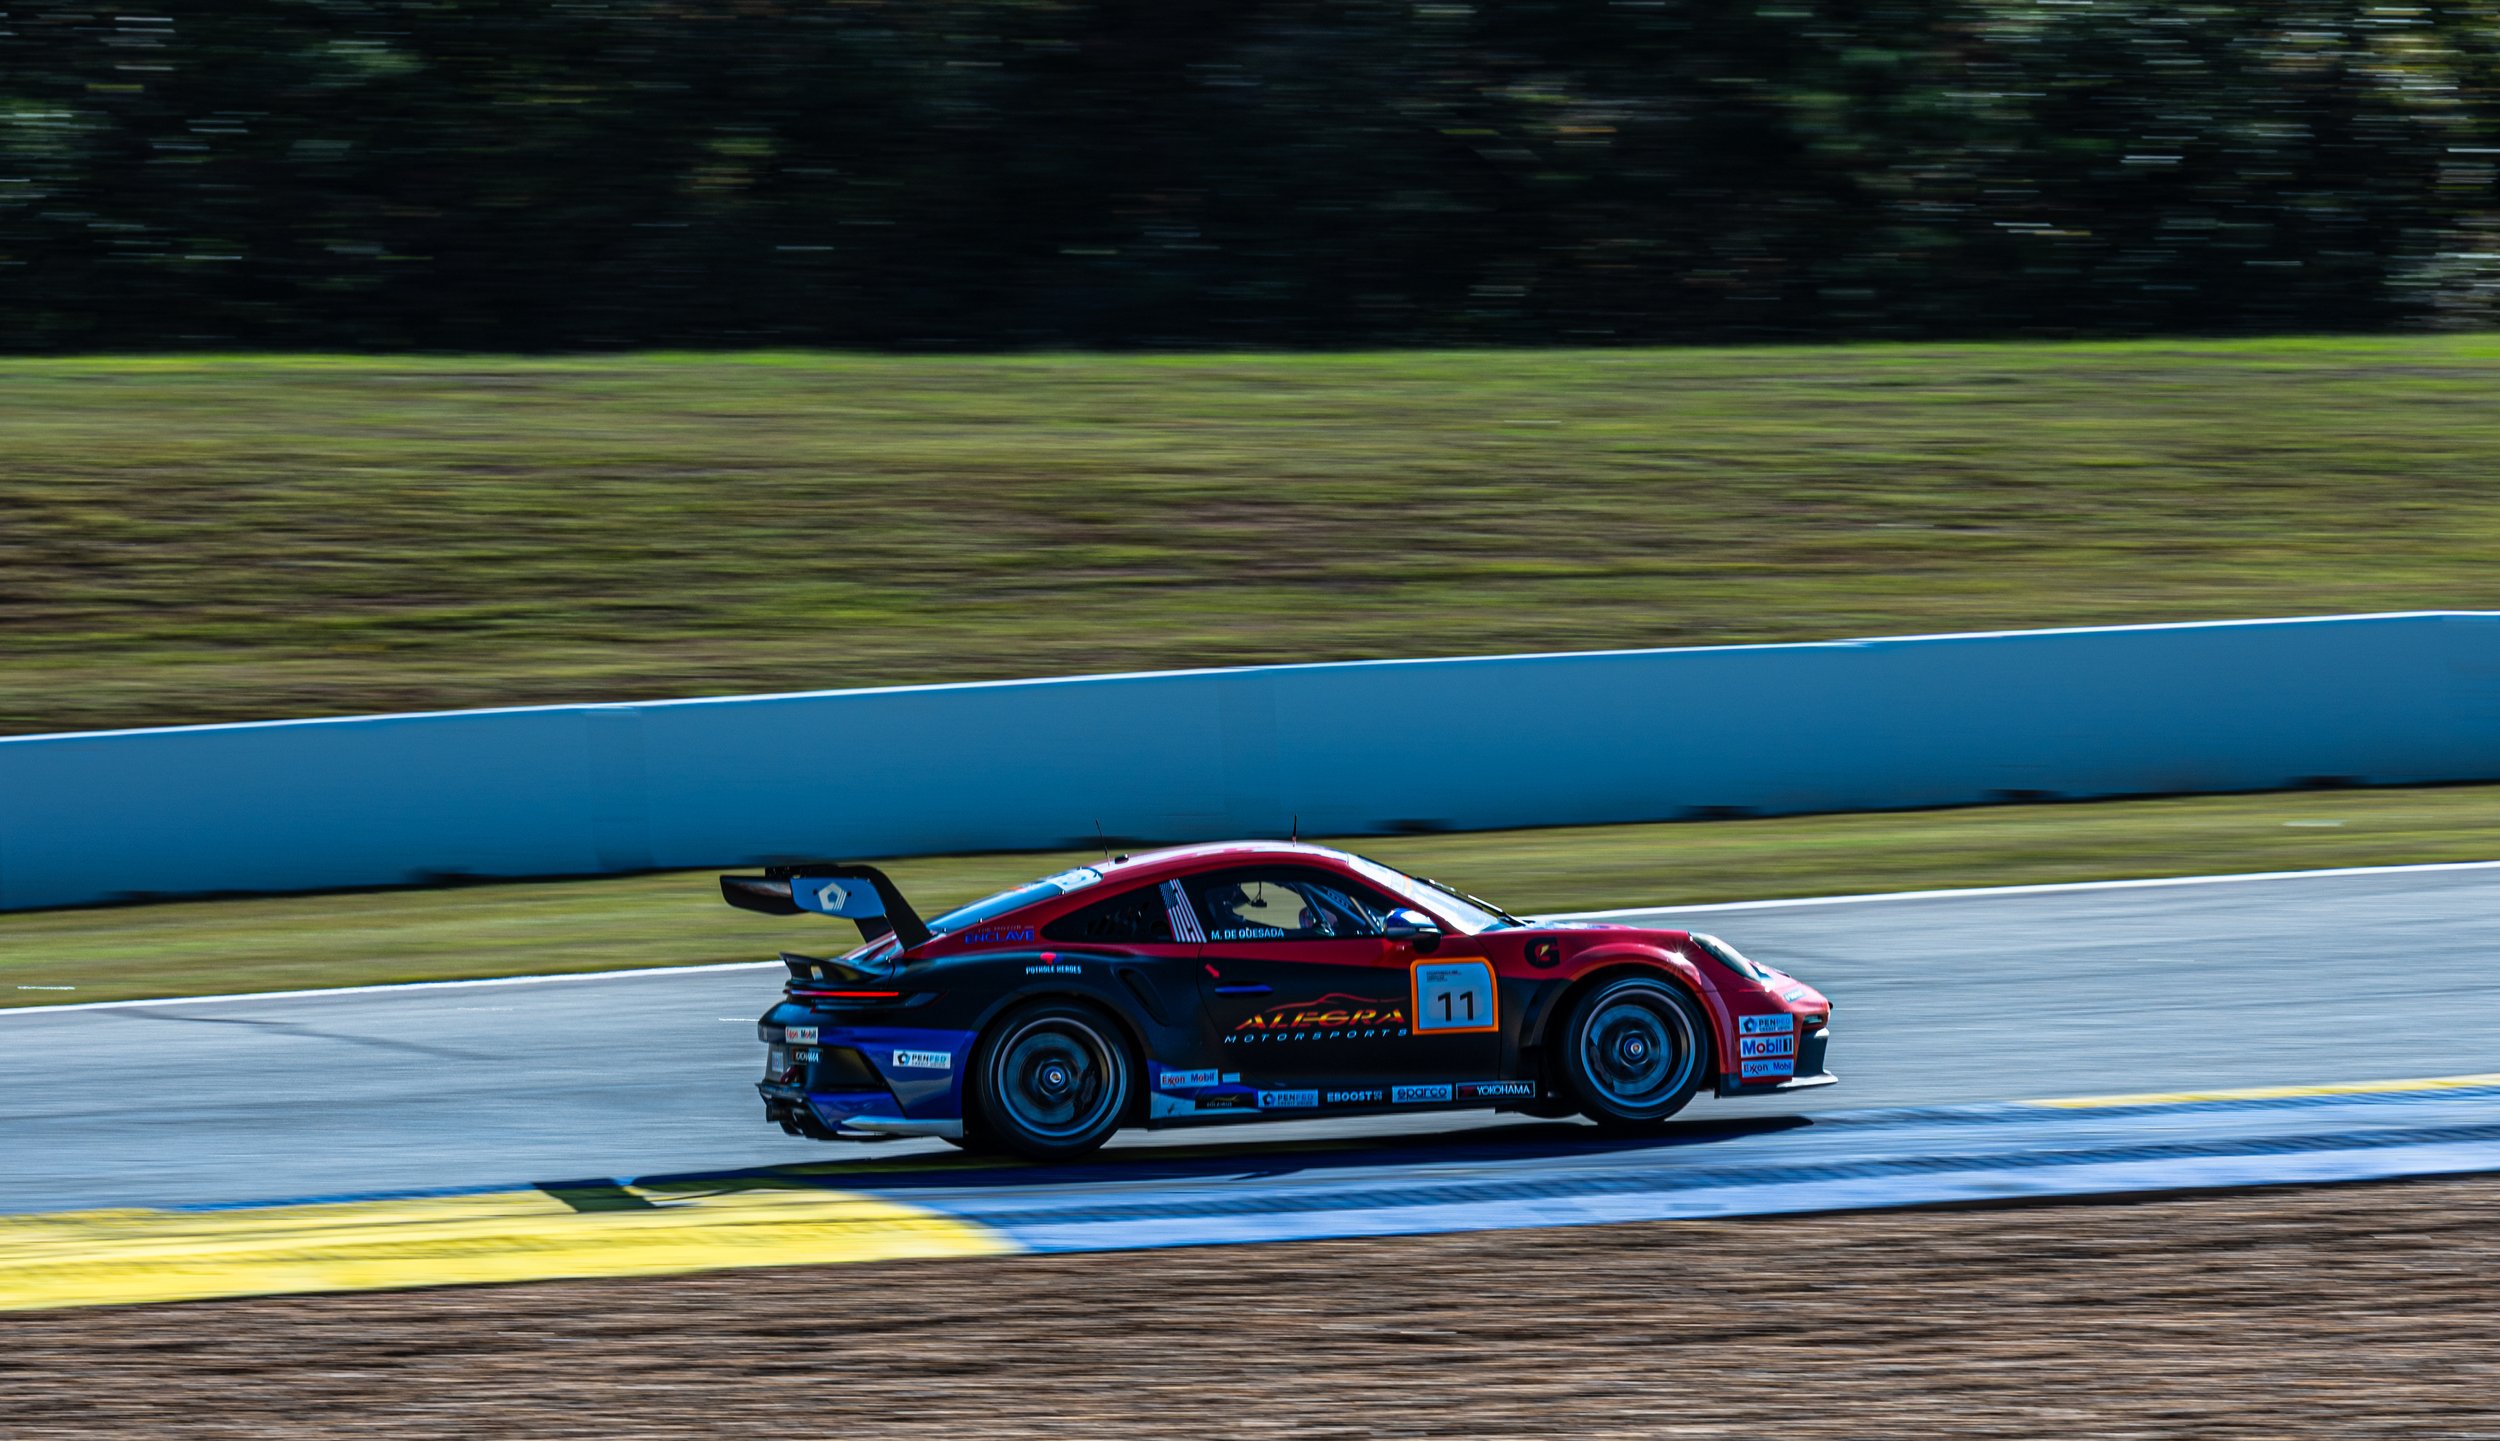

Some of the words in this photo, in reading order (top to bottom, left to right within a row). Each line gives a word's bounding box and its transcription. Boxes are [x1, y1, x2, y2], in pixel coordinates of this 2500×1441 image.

[965, 930, 1035, 944] ENCLAVE
[1211, 929, 1222, 940] M.
[1224, 928, 1237, 940] DE
[1239, 927, 1284, 939] QUESADA
[1524, 936, 1560, 970] G
[1025, 965, 1055, 975] POTHOLE
[1056, 964, 1081, 974] HEROES
[1437, 990, 1474, 1022] 11
[1235, 1008, 1405, 1031] ALEGRA
[1224, 1028, 1407, 1044] MOTORSPORTS
[1742, 1038, 1783, 1055] Mobil
[911, 1053, 947, 1064] PENFED
[1743, 1063, 1769, 1075] Exxon
[1773, 1061, 1791, 1070] Mobil
[1161, 1074, 1186, 1085] Exxon
[1190, 1071, 1215, 1083] Mobil
[1477, 1084, 1531, 1096] YOKOHAMA
